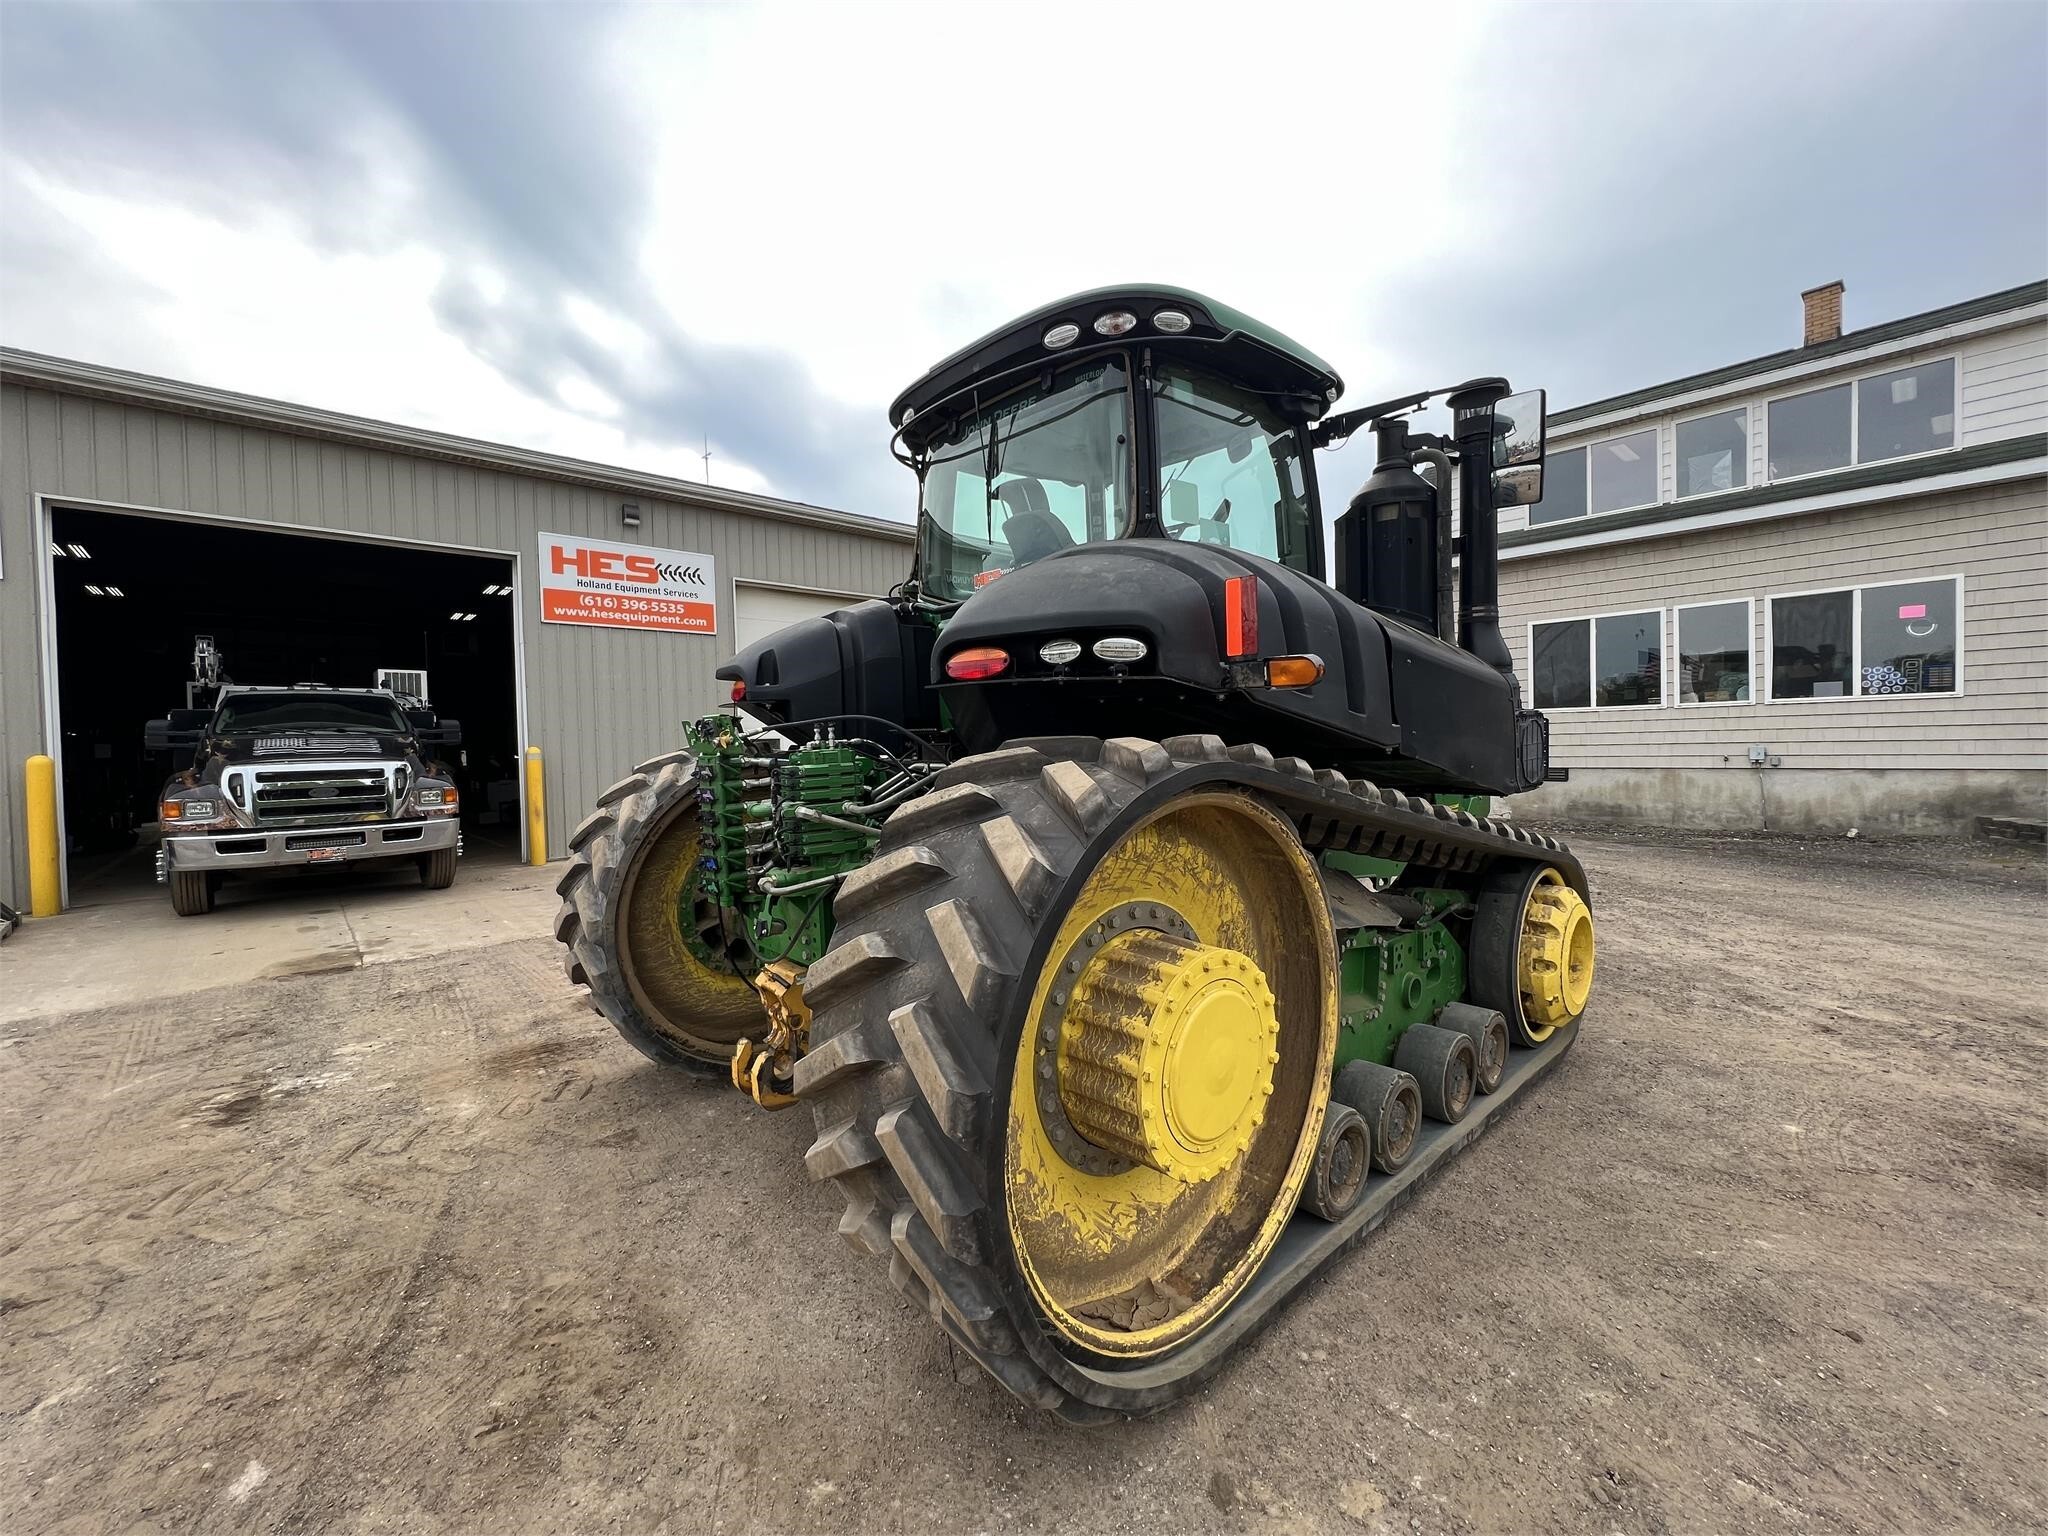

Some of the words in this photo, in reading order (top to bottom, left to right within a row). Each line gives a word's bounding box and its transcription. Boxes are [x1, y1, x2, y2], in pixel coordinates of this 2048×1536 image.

[962, 416, 991, 440] JOHN
[994, 396, 1037, 419] DEERE
[551, 546, 659, 584] HES
[577, 579, 612, 591] Holland
[615, 583, 661, 595] Equipment
[664, 588, 699, 599] Services
[580, 594, 617, 609] (616)
[621, 599, 685, 614] 396-5535
[554, 607, 707, 626] www.hesequipment.com
